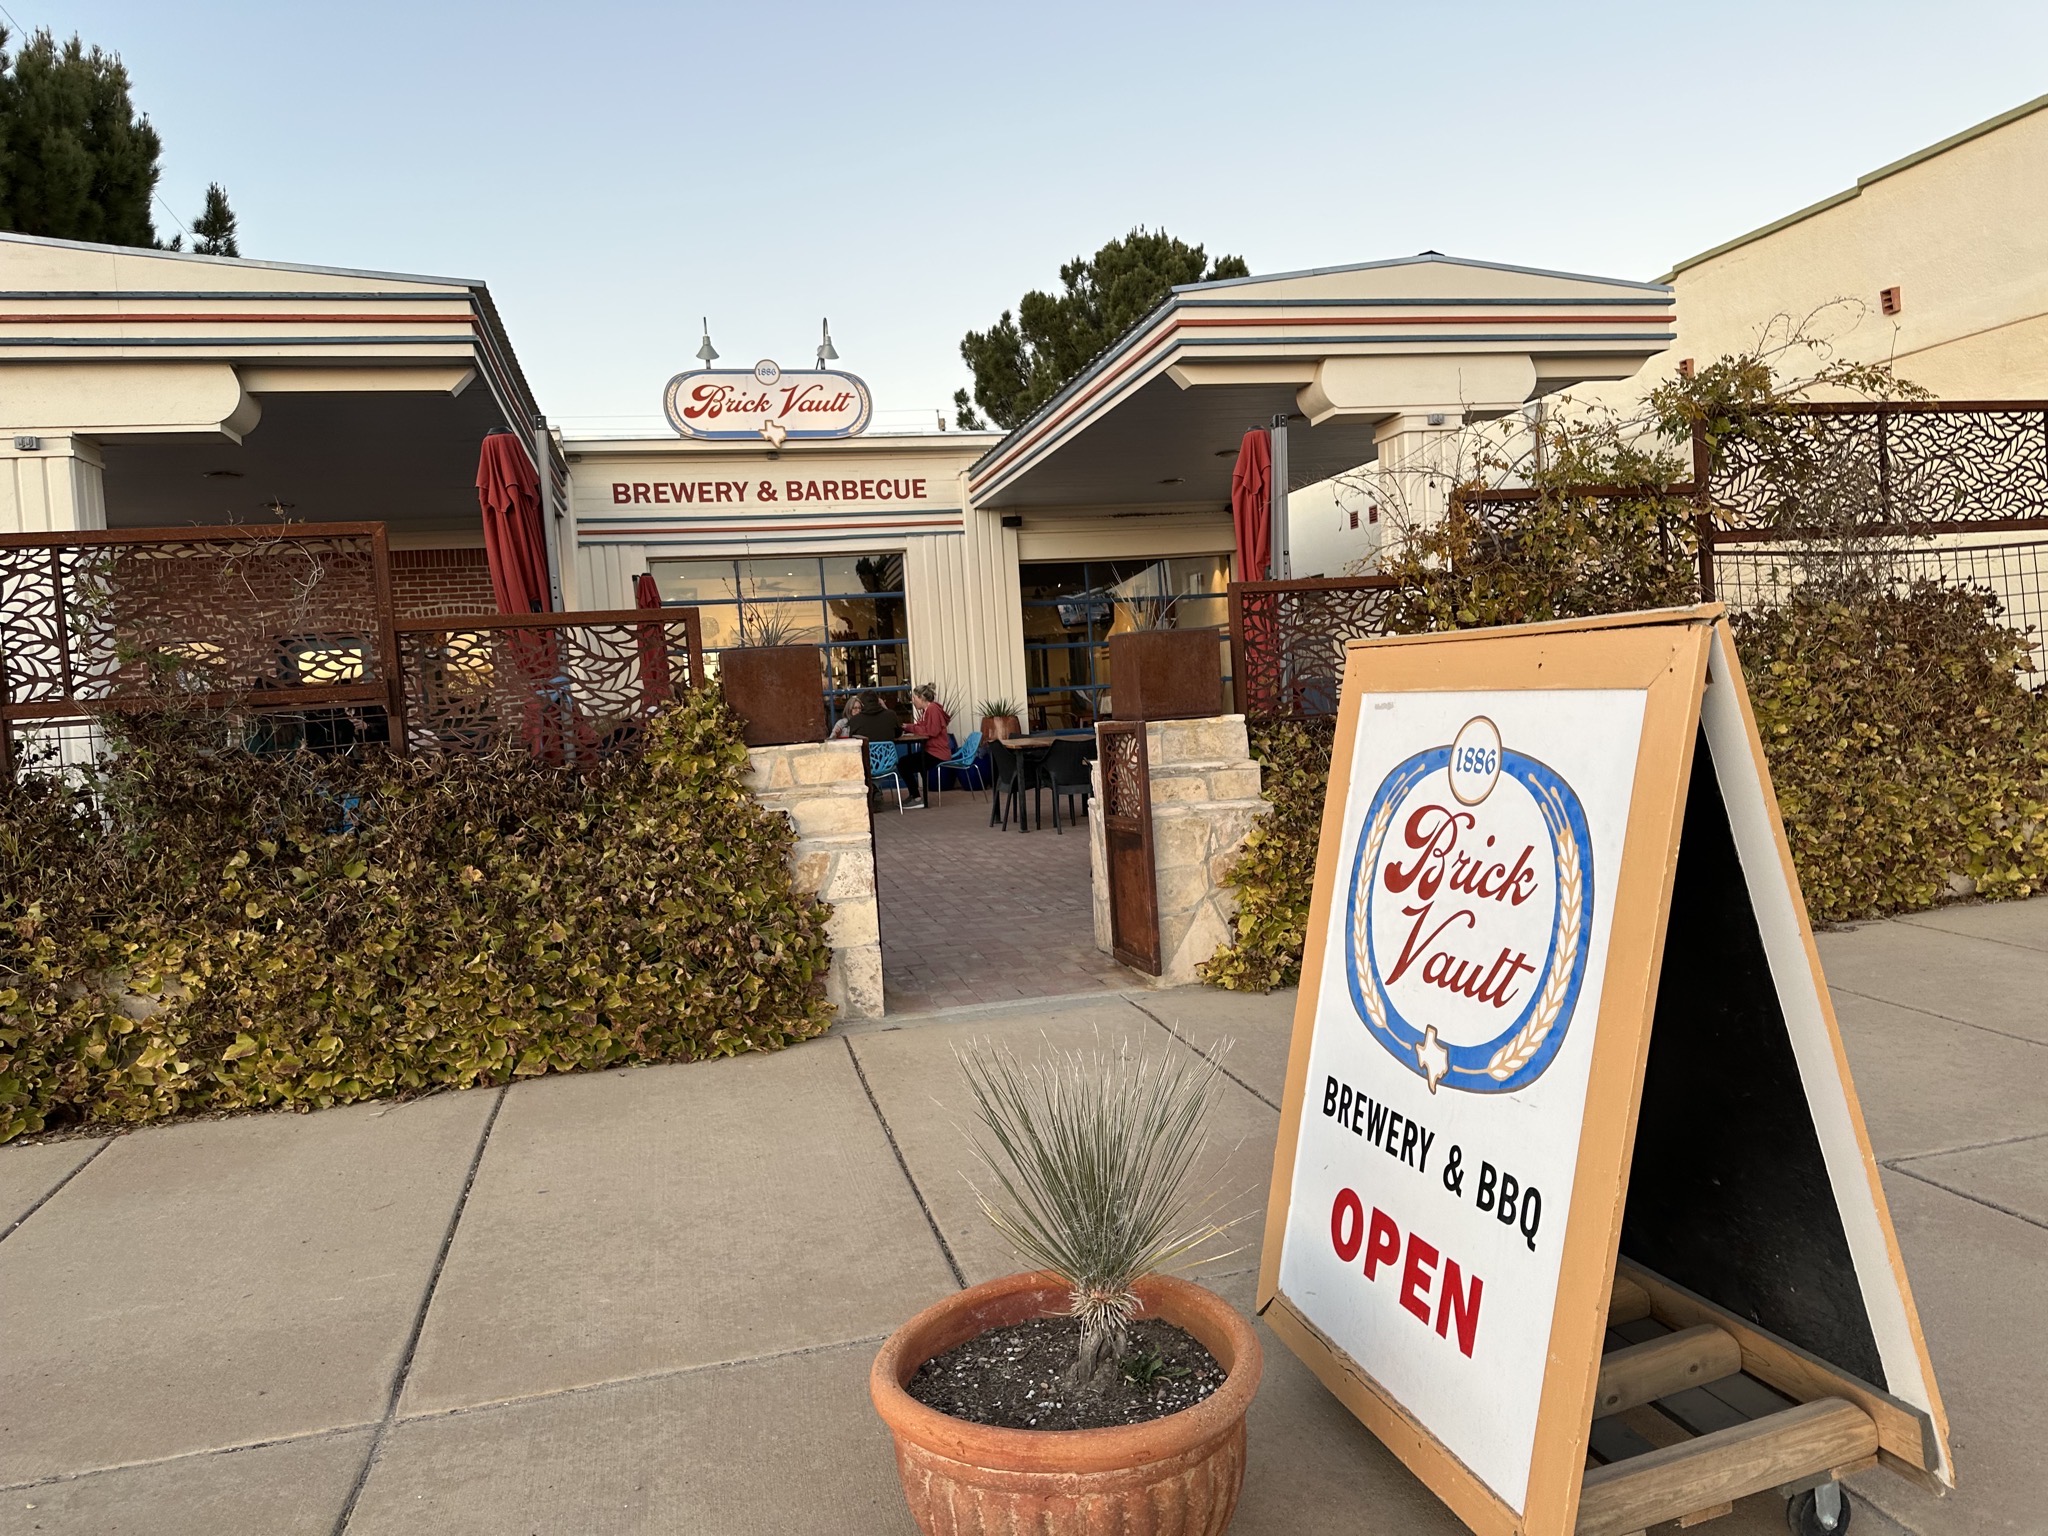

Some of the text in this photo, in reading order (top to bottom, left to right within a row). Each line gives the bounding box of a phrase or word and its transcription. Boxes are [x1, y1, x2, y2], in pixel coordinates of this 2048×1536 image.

[683, 384, 856, 419] Brick Vault
[757, 368, 777, 376] 1886
[612, 478, 927, 504] BREWERY & BARBECUE
[1455, 746, 1497, 774] 1886
[1384, 804, 1538, 907] Brick
[1385, 900, 1537, 1009] Vault
[1322, 1075, 1543, 1253] BREWERY & BBQ
[1330, 1187, 1484, 1360] OPEN
